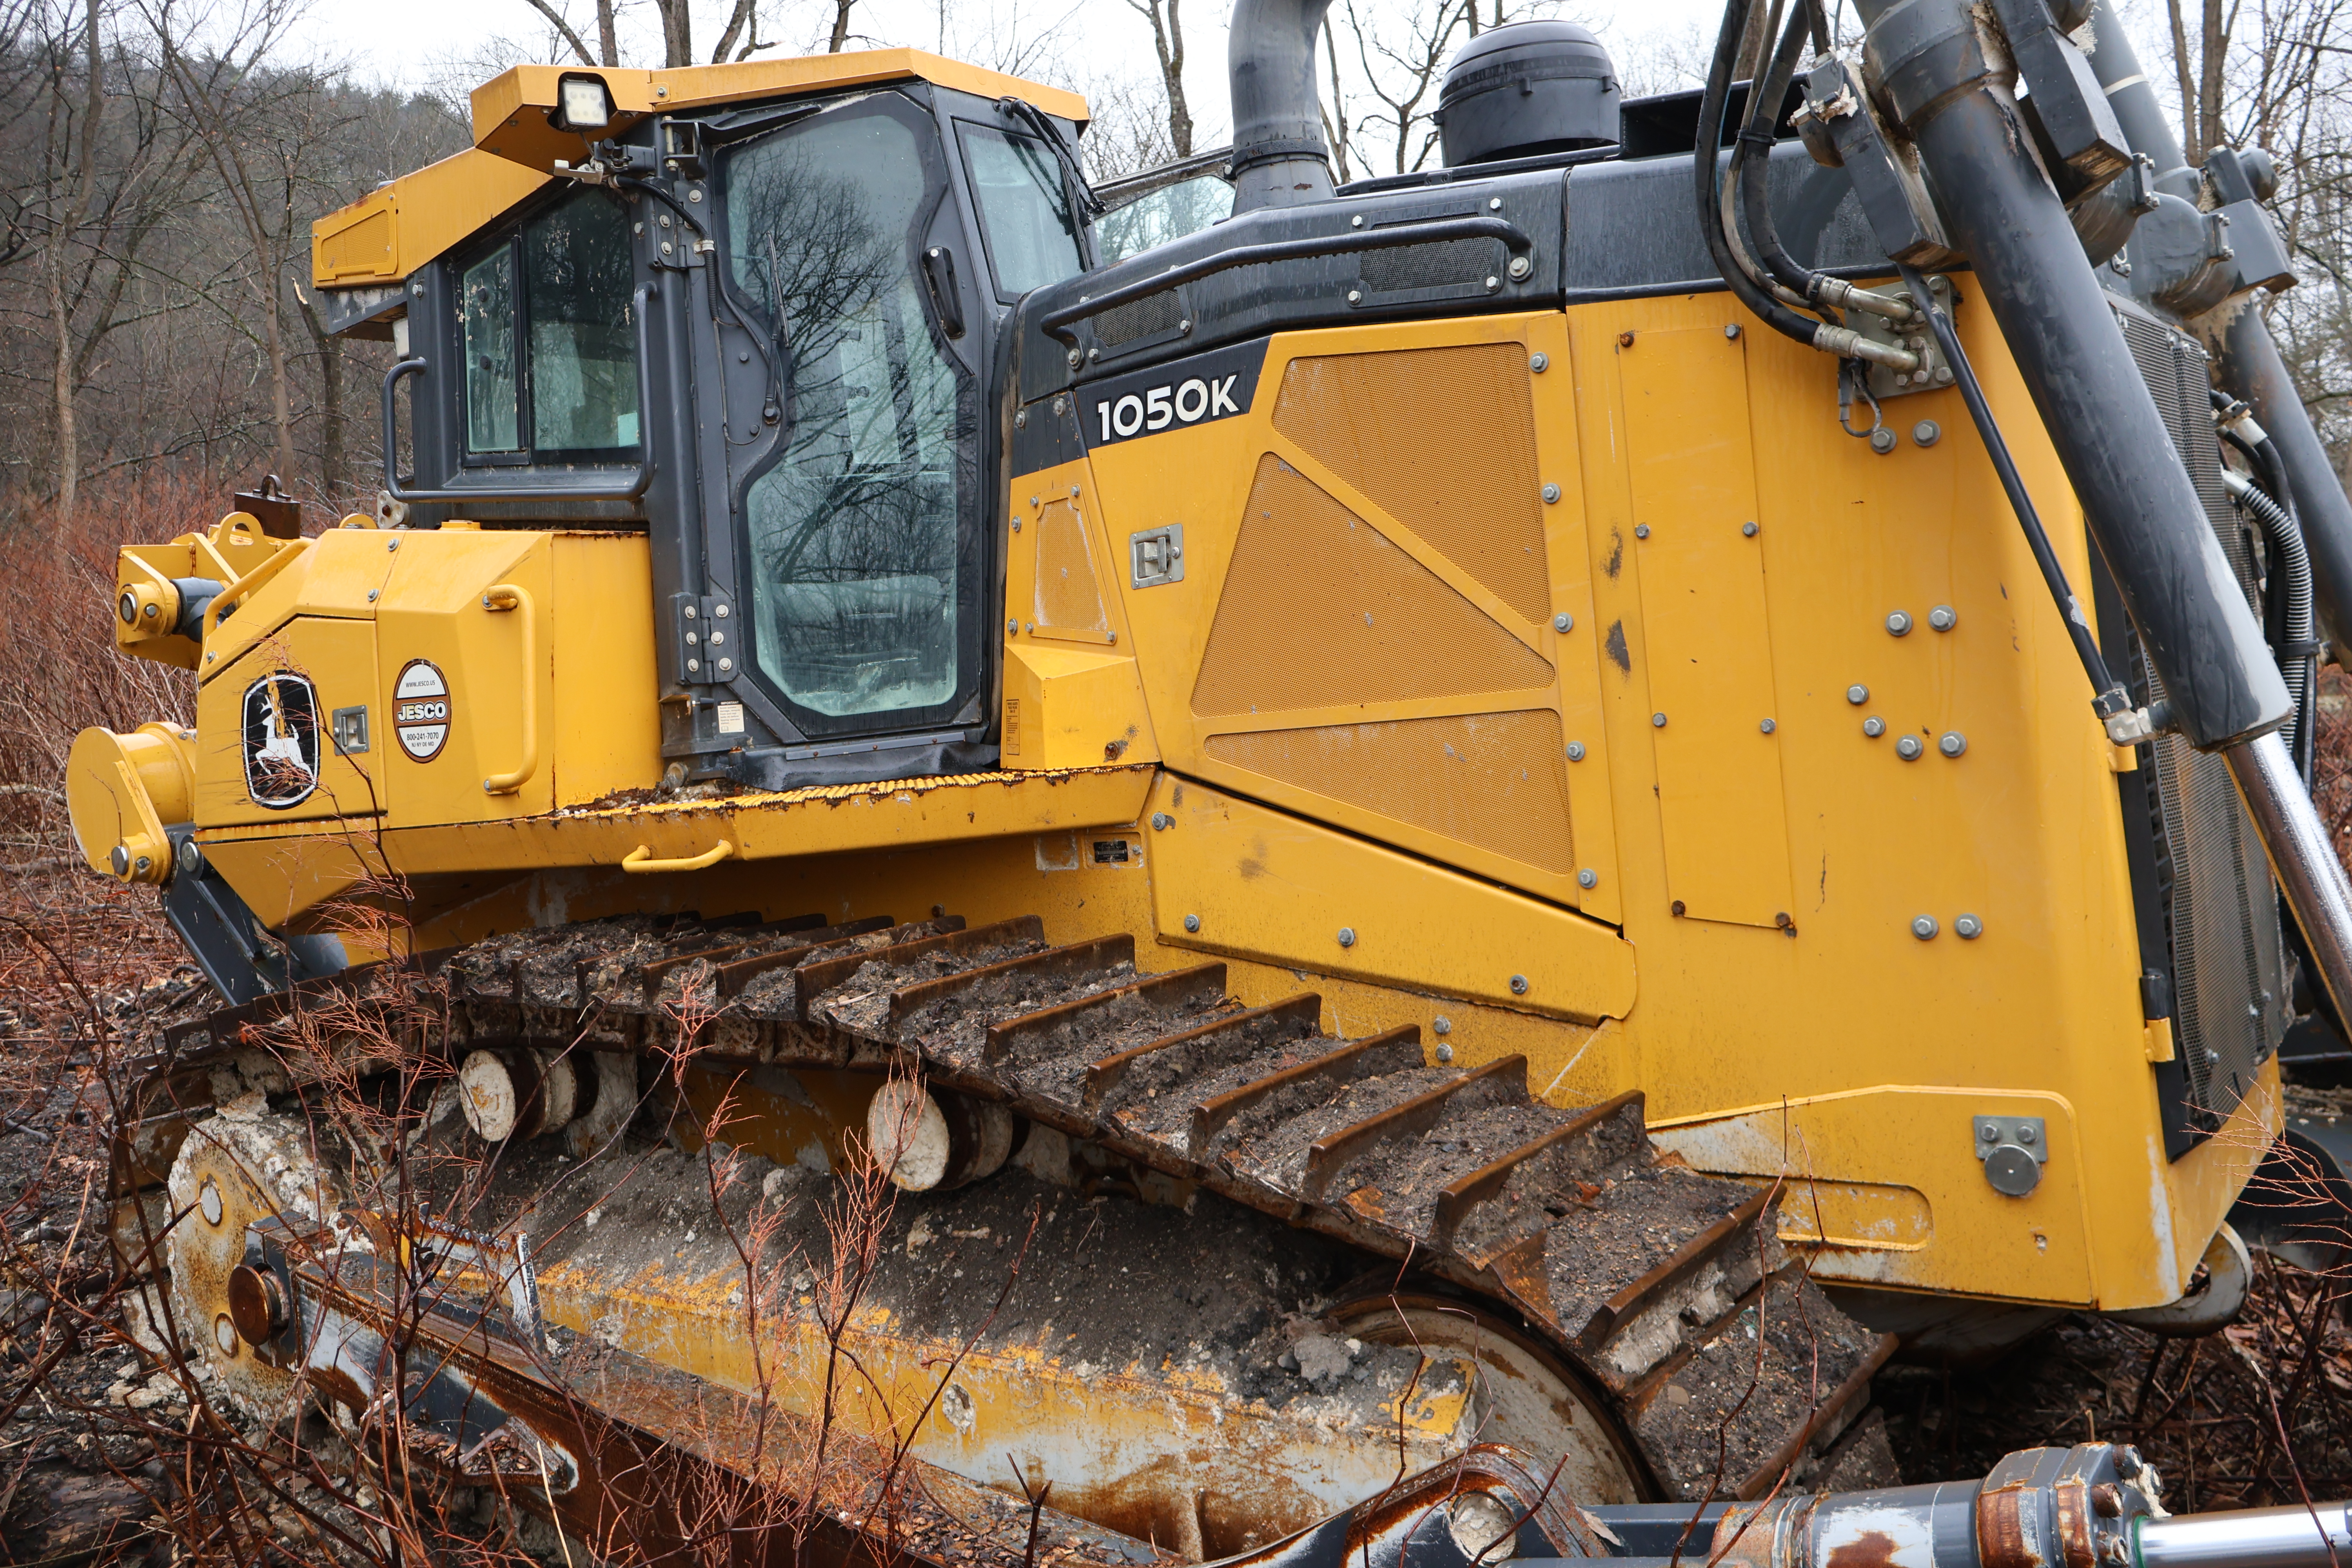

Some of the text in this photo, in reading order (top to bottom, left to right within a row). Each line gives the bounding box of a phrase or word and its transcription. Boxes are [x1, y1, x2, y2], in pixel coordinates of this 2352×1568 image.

[1098, 375, 1239, 441] 1050K
[406, 680, 435, 688] WWW.JESCO.US
[397, 701, 447, 722] JESCO
[407, 732, 439, 741] 800-241-7070
